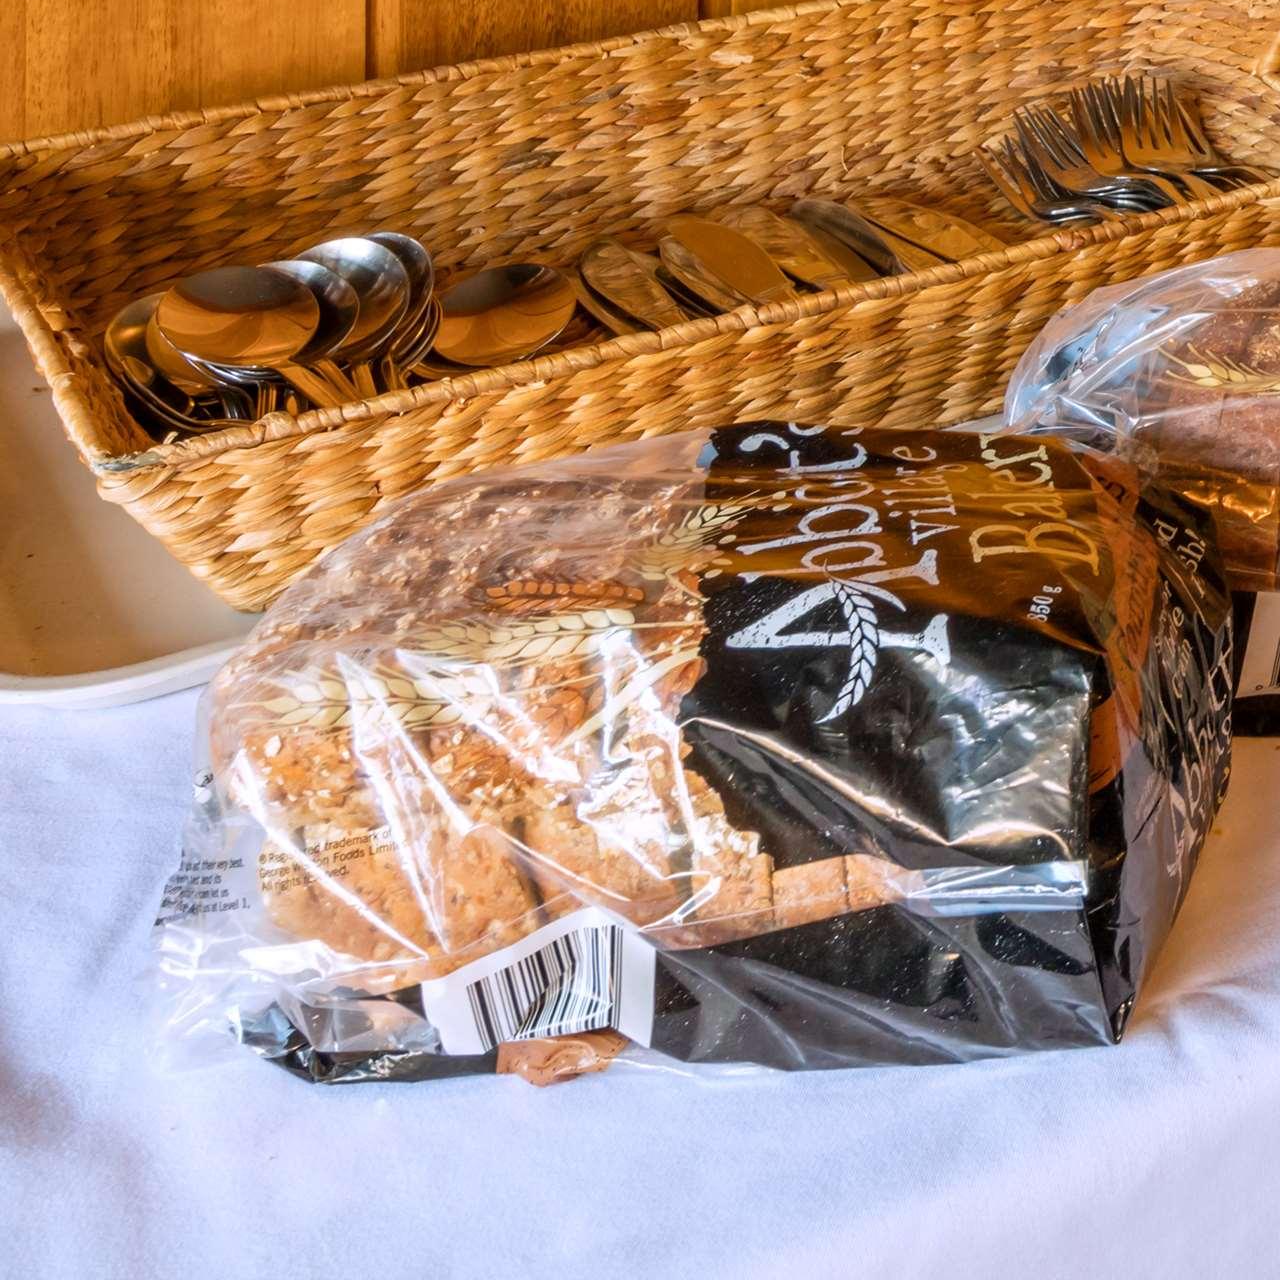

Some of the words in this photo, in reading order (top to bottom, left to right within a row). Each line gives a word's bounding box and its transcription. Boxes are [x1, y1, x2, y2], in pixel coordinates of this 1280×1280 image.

[1026, 593, 1055, 624] 850
[324, 833, 378, 852] trademark
[332, 849, 366, 864] Foods
